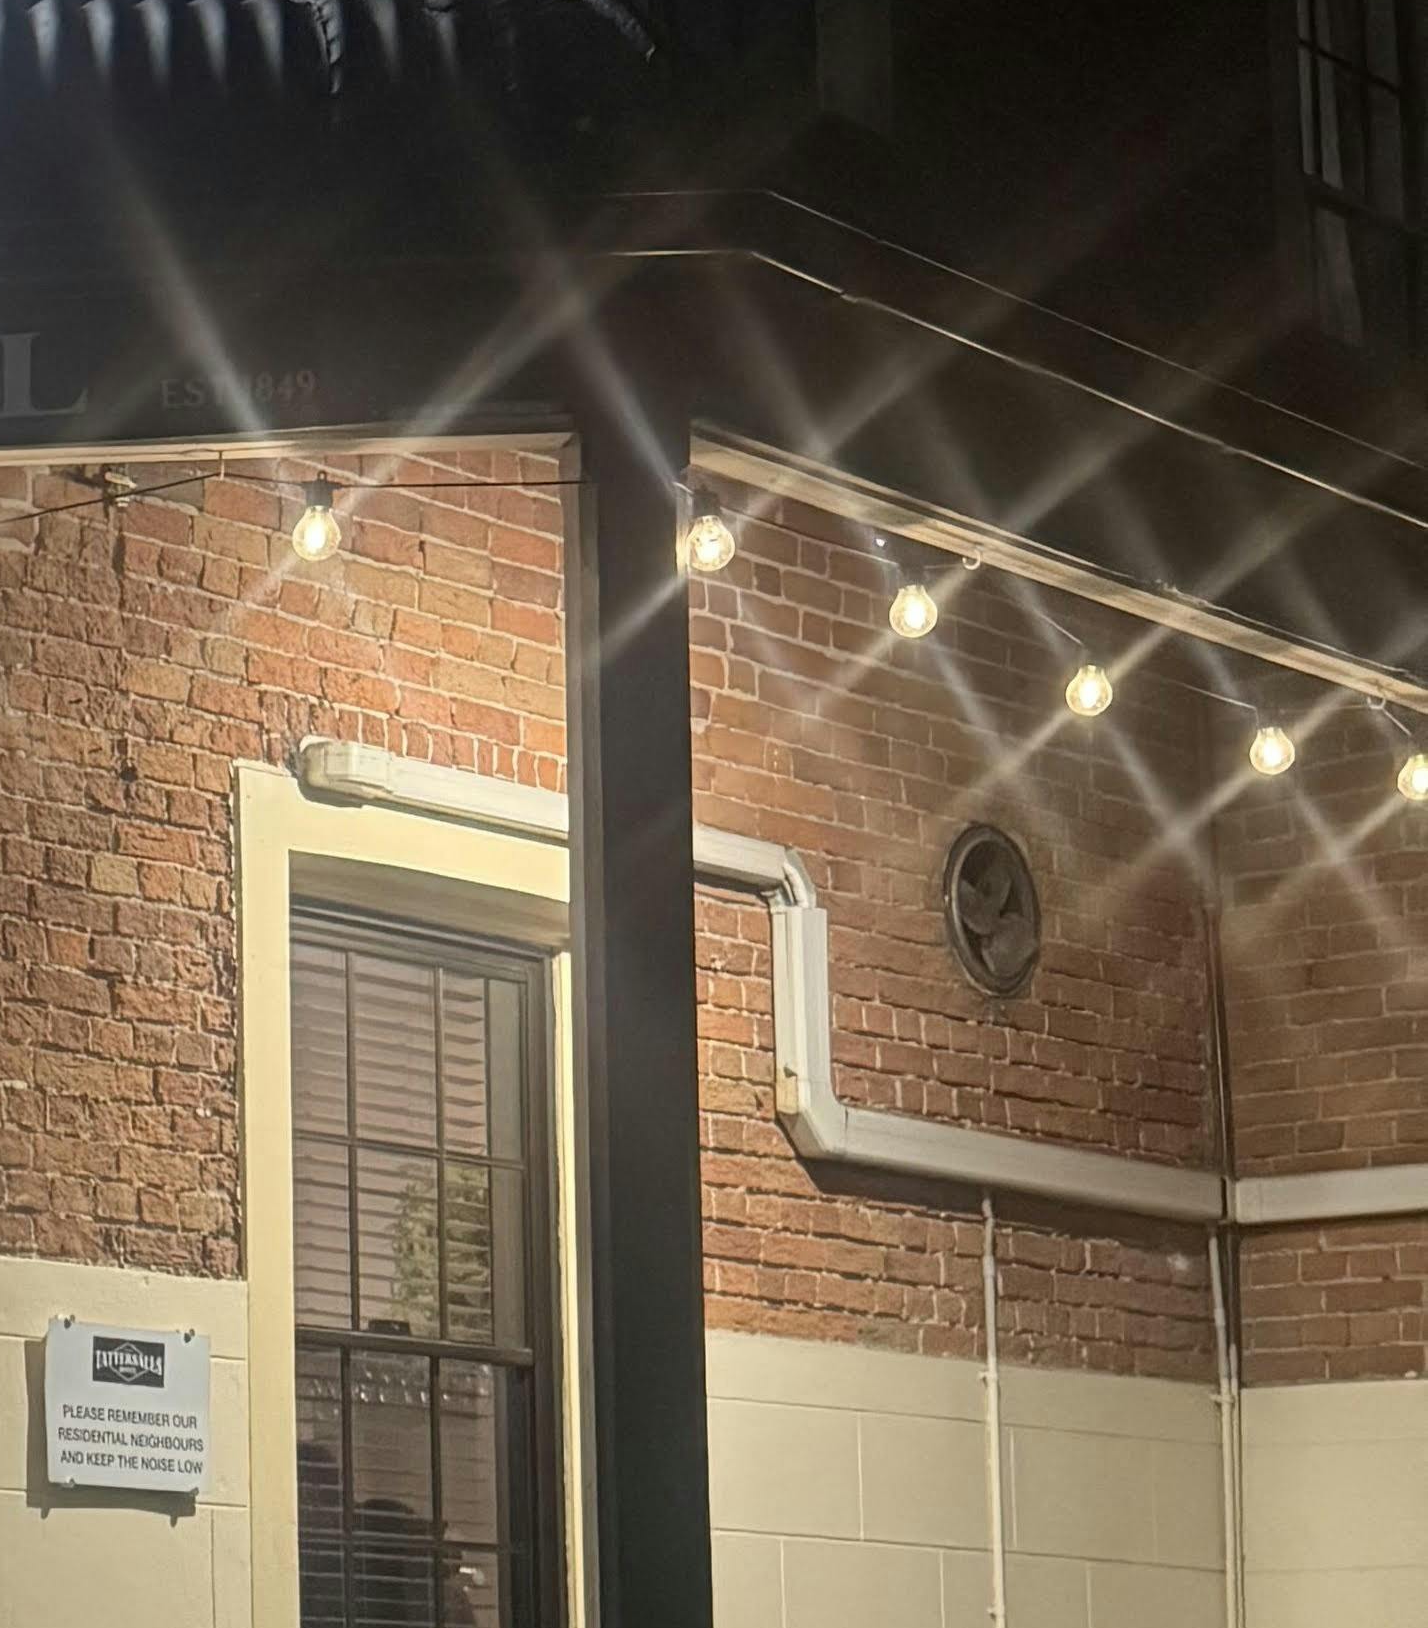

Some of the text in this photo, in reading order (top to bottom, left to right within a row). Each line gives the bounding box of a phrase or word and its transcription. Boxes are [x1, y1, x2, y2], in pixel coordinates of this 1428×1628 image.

[63, 1404, 197, 1429] PLEASE REMEMBER OUR
[58, 1427, 204, 1452] RESIDENTIAL NEIGHBOURS
[60, 1450, 203, 1475] AND KEEP THE NOISE LOW
